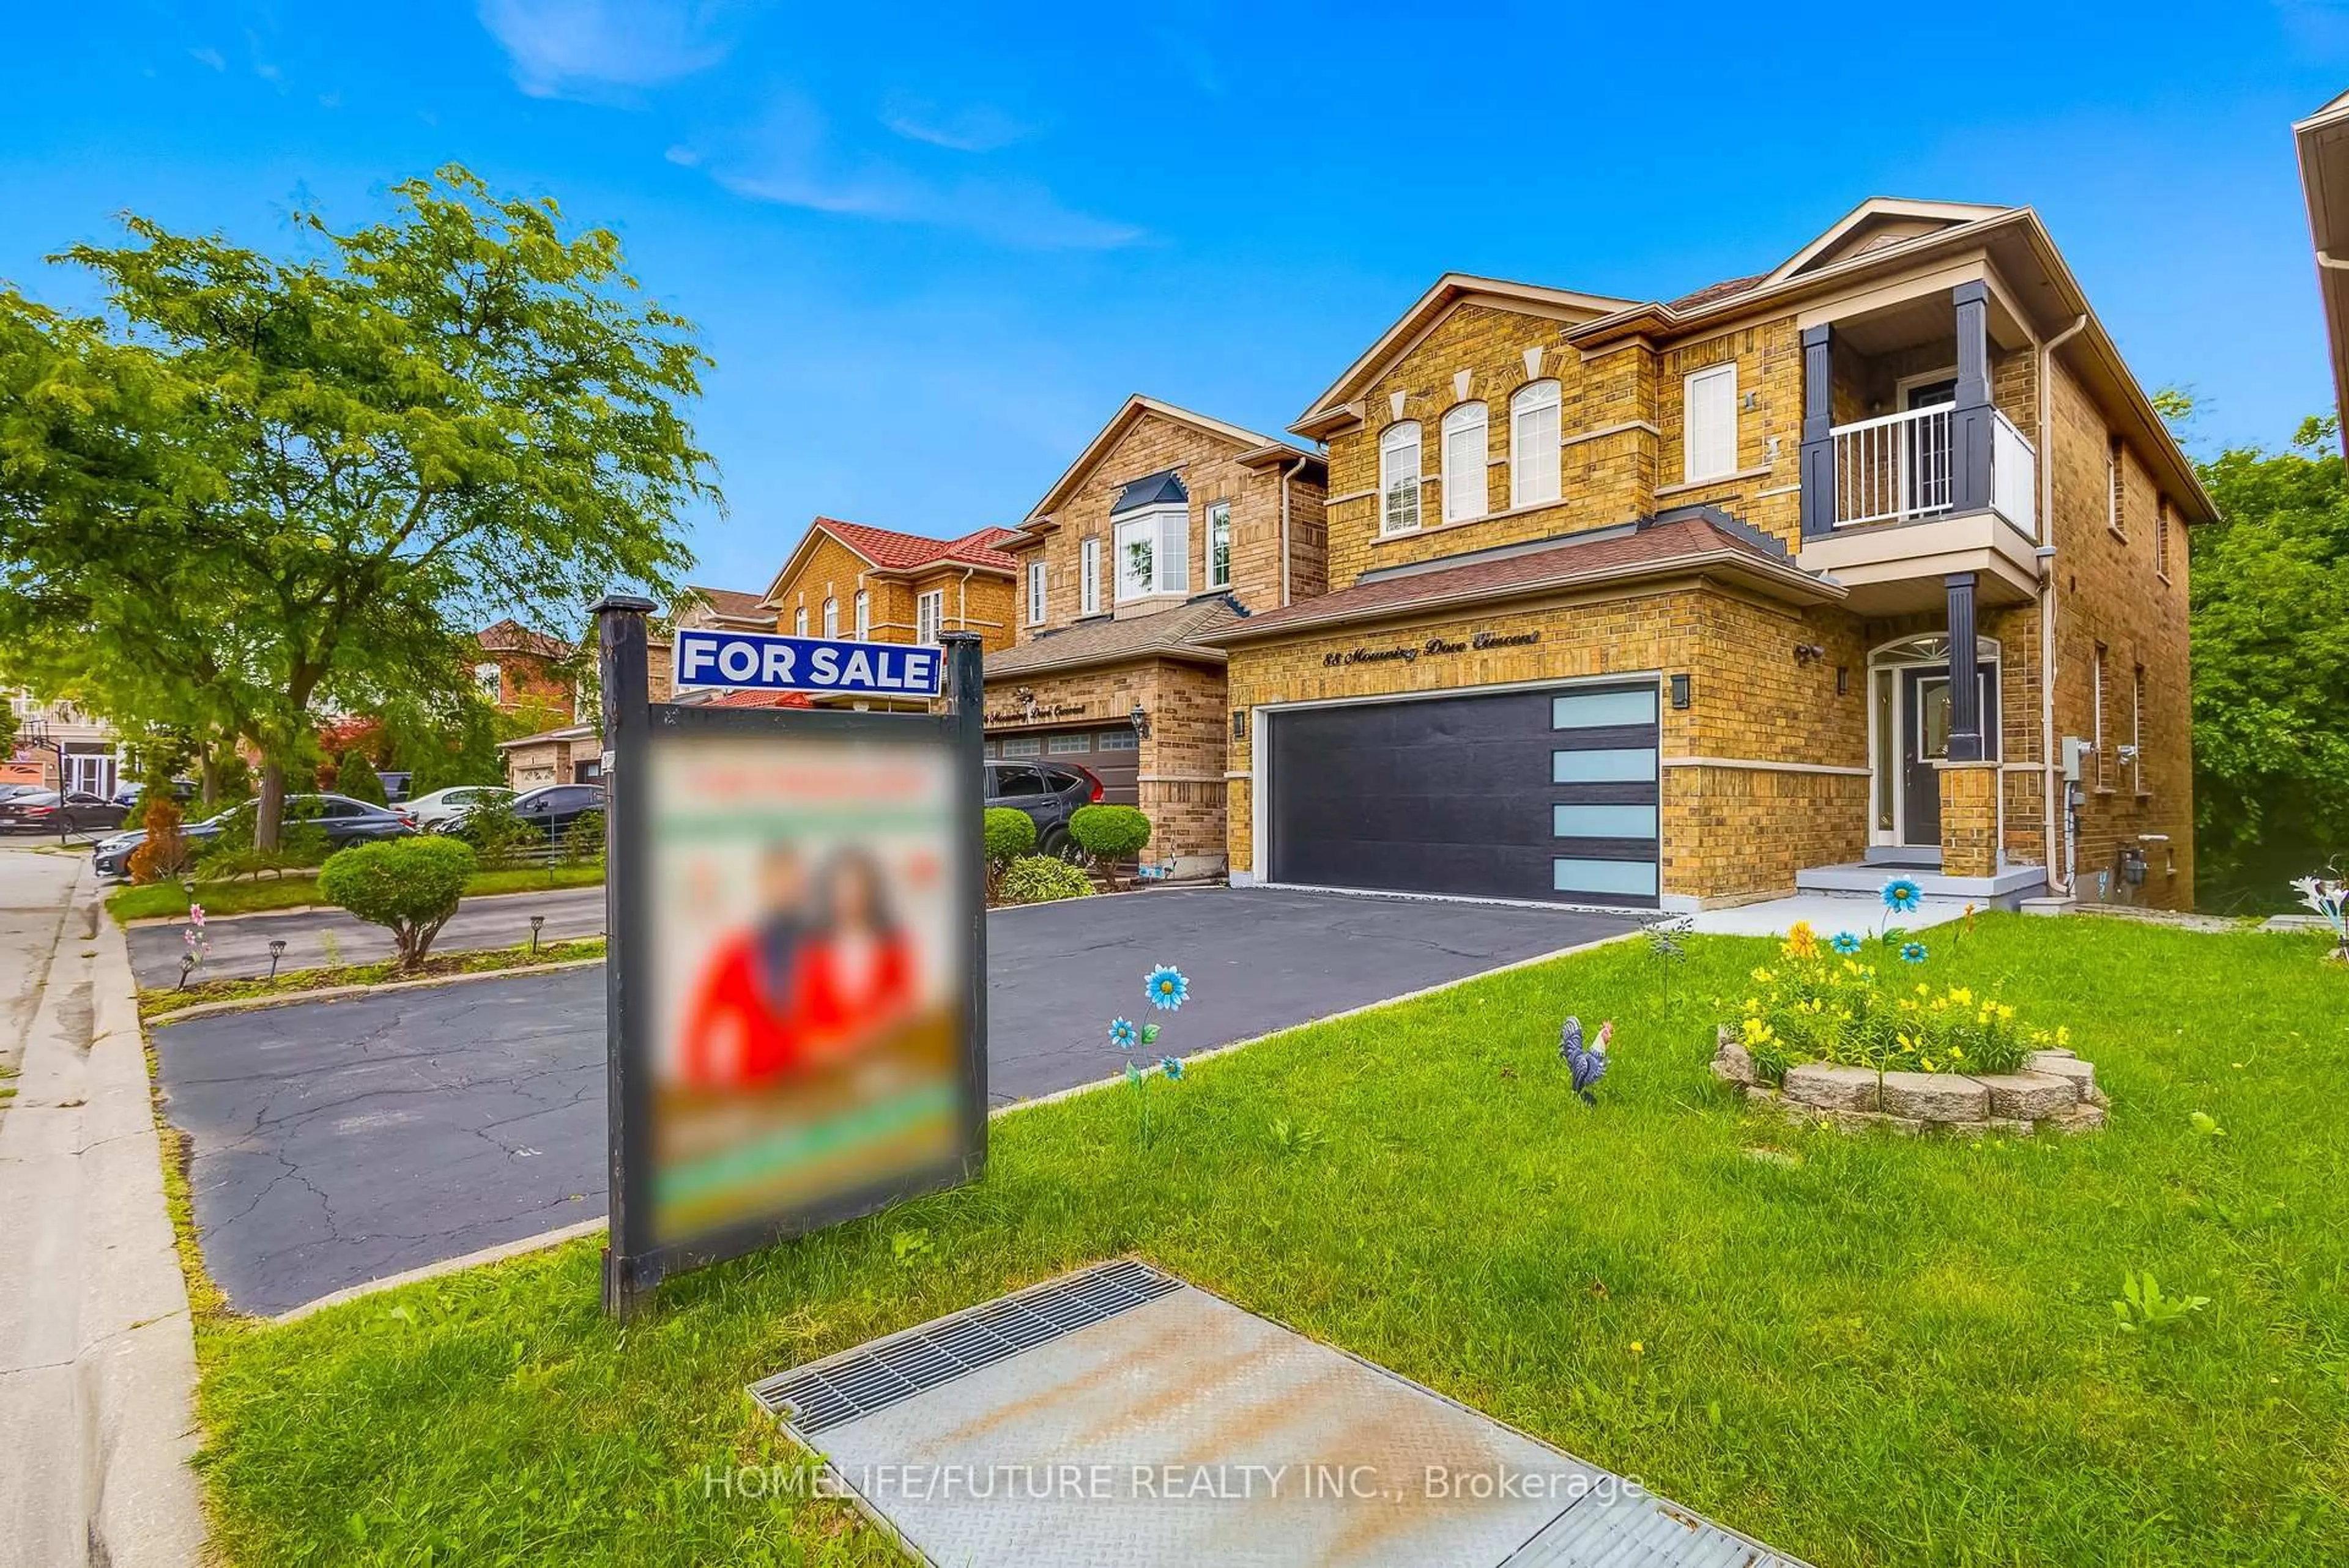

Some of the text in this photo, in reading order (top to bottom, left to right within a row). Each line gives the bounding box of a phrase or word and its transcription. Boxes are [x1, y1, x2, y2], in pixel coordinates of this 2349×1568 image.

[683, 638, 796, 684] FOR
[809, 647, 931, 689] SALE
[1323, 653, 1341, 667] 88
[1423, 638, 1467, 656] Dove
[1473, 630, 1540, 649] Crescent
